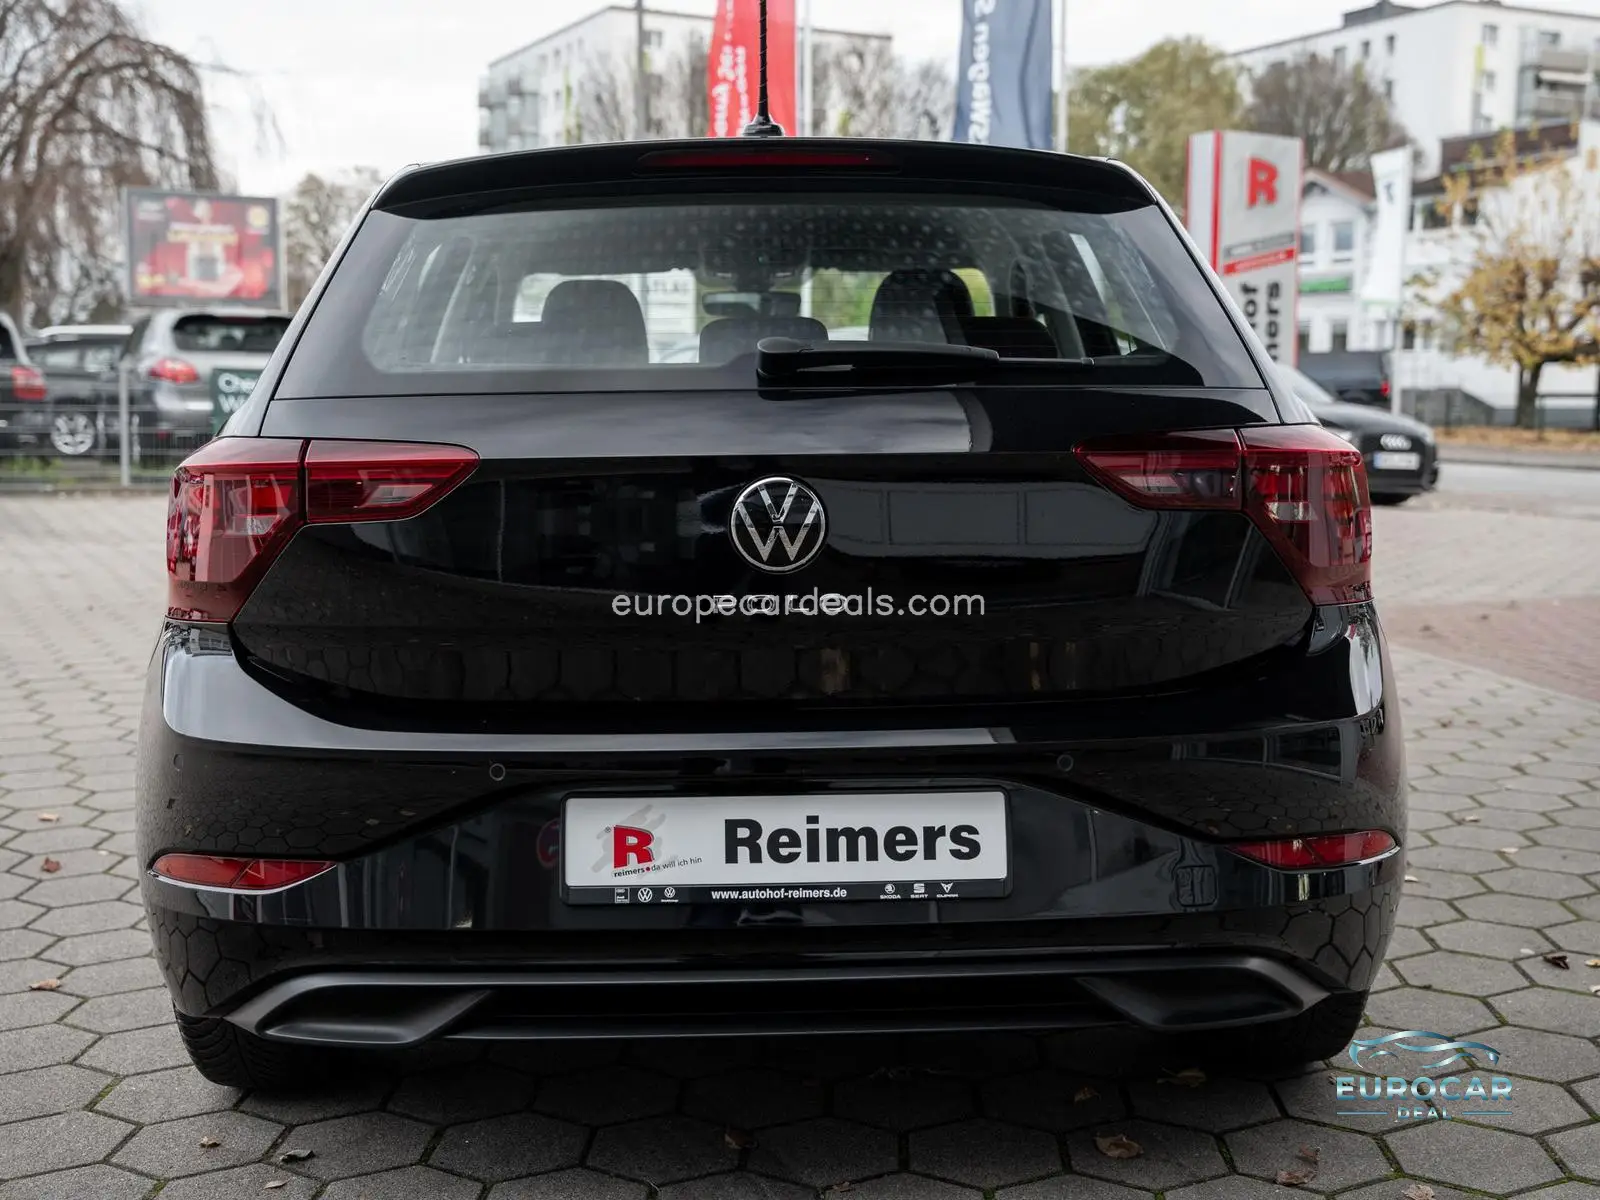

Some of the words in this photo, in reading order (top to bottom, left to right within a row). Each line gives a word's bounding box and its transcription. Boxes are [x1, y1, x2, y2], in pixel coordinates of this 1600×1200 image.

[1246, 156, 1278, 207] R
[1239, 281, 1258, 329] of
[614, 825, 654, 868] R
[724, 815, 982, 865] Reimers
[614, 867, 645, 877] reimers
[651, 864, 661, 872] da
[678, 859, 688, 867] ich
[690, 856, 702, 865] hin
[711, 887, 847, 900] www.autohof-reimers.de
